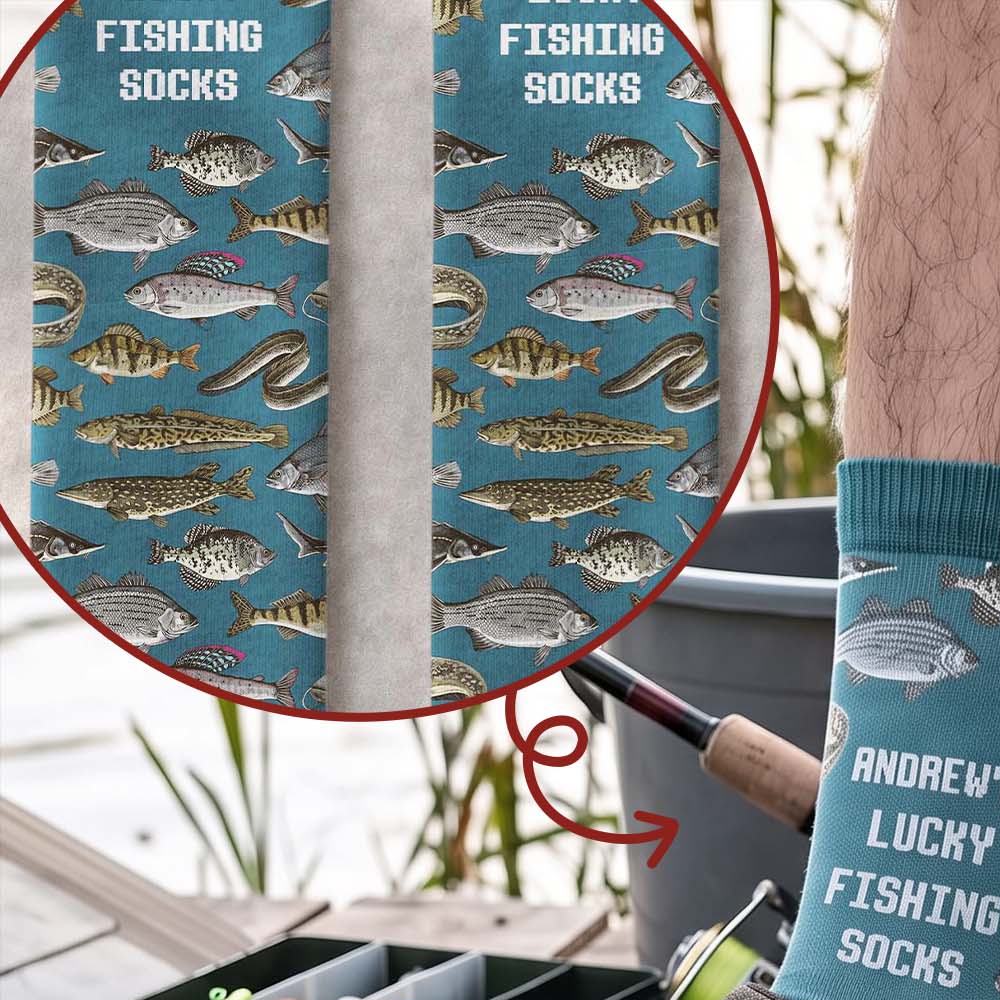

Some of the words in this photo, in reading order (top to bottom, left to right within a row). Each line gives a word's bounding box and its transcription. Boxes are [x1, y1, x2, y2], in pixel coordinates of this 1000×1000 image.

[97, 20, 262, 52] FISHING
[500, 23, 665, 56] FISHING
[119, 69, 238, 101] SOCKS
[524, 72, 641, 104] SOCKS
[866, 809, 996, 866] LUCKY
[836, 928, 965, 988] SOCKS
